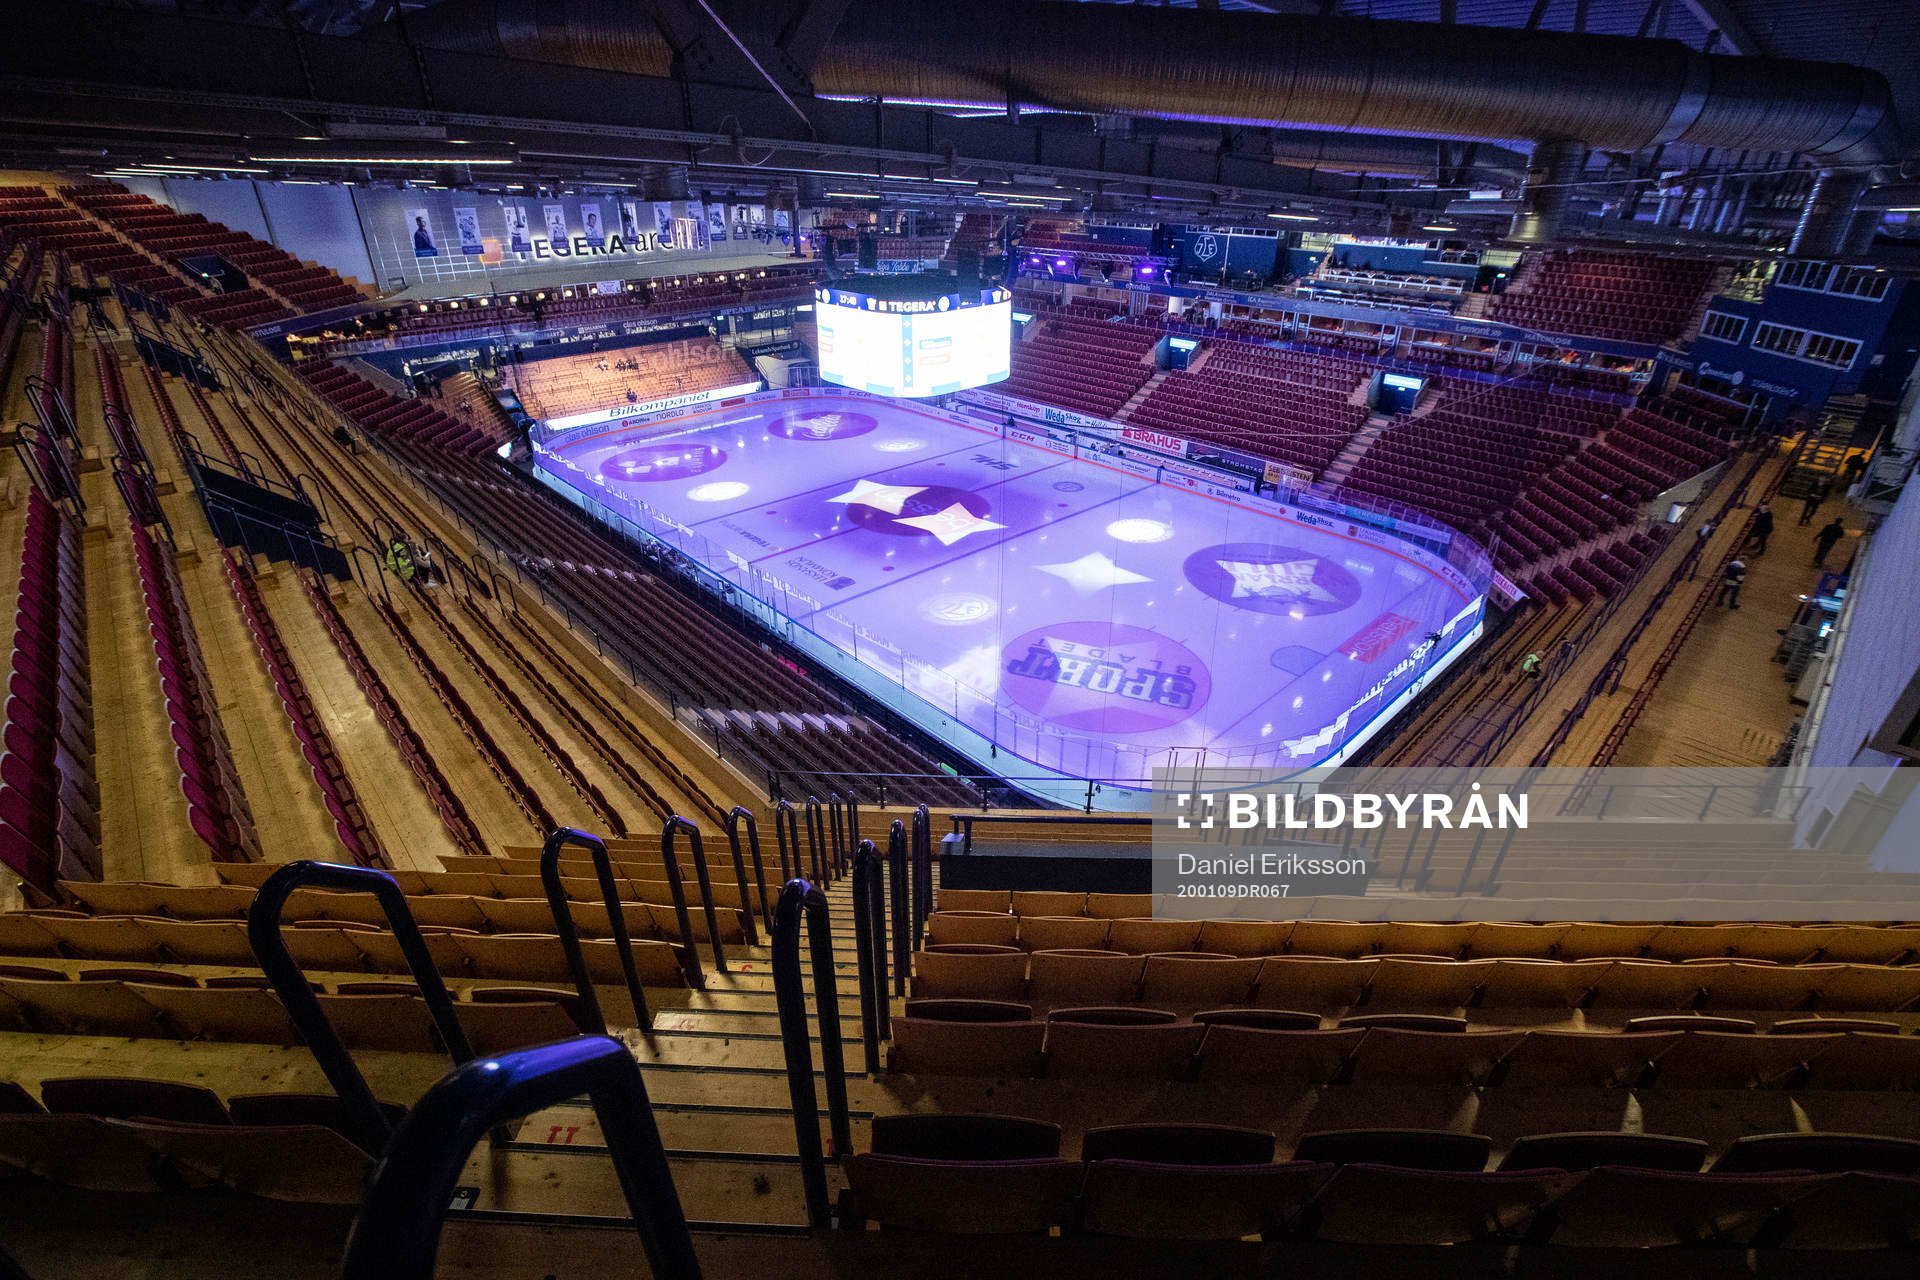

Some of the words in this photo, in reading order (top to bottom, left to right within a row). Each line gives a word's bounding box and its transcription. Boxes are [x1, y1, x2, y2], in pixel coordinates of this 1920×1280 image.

[609, 392, 711, 417] Bilkompaniet
[1045, 408, 1065, 424] Weda
[1007, 646, 1197, 710] SPORT
